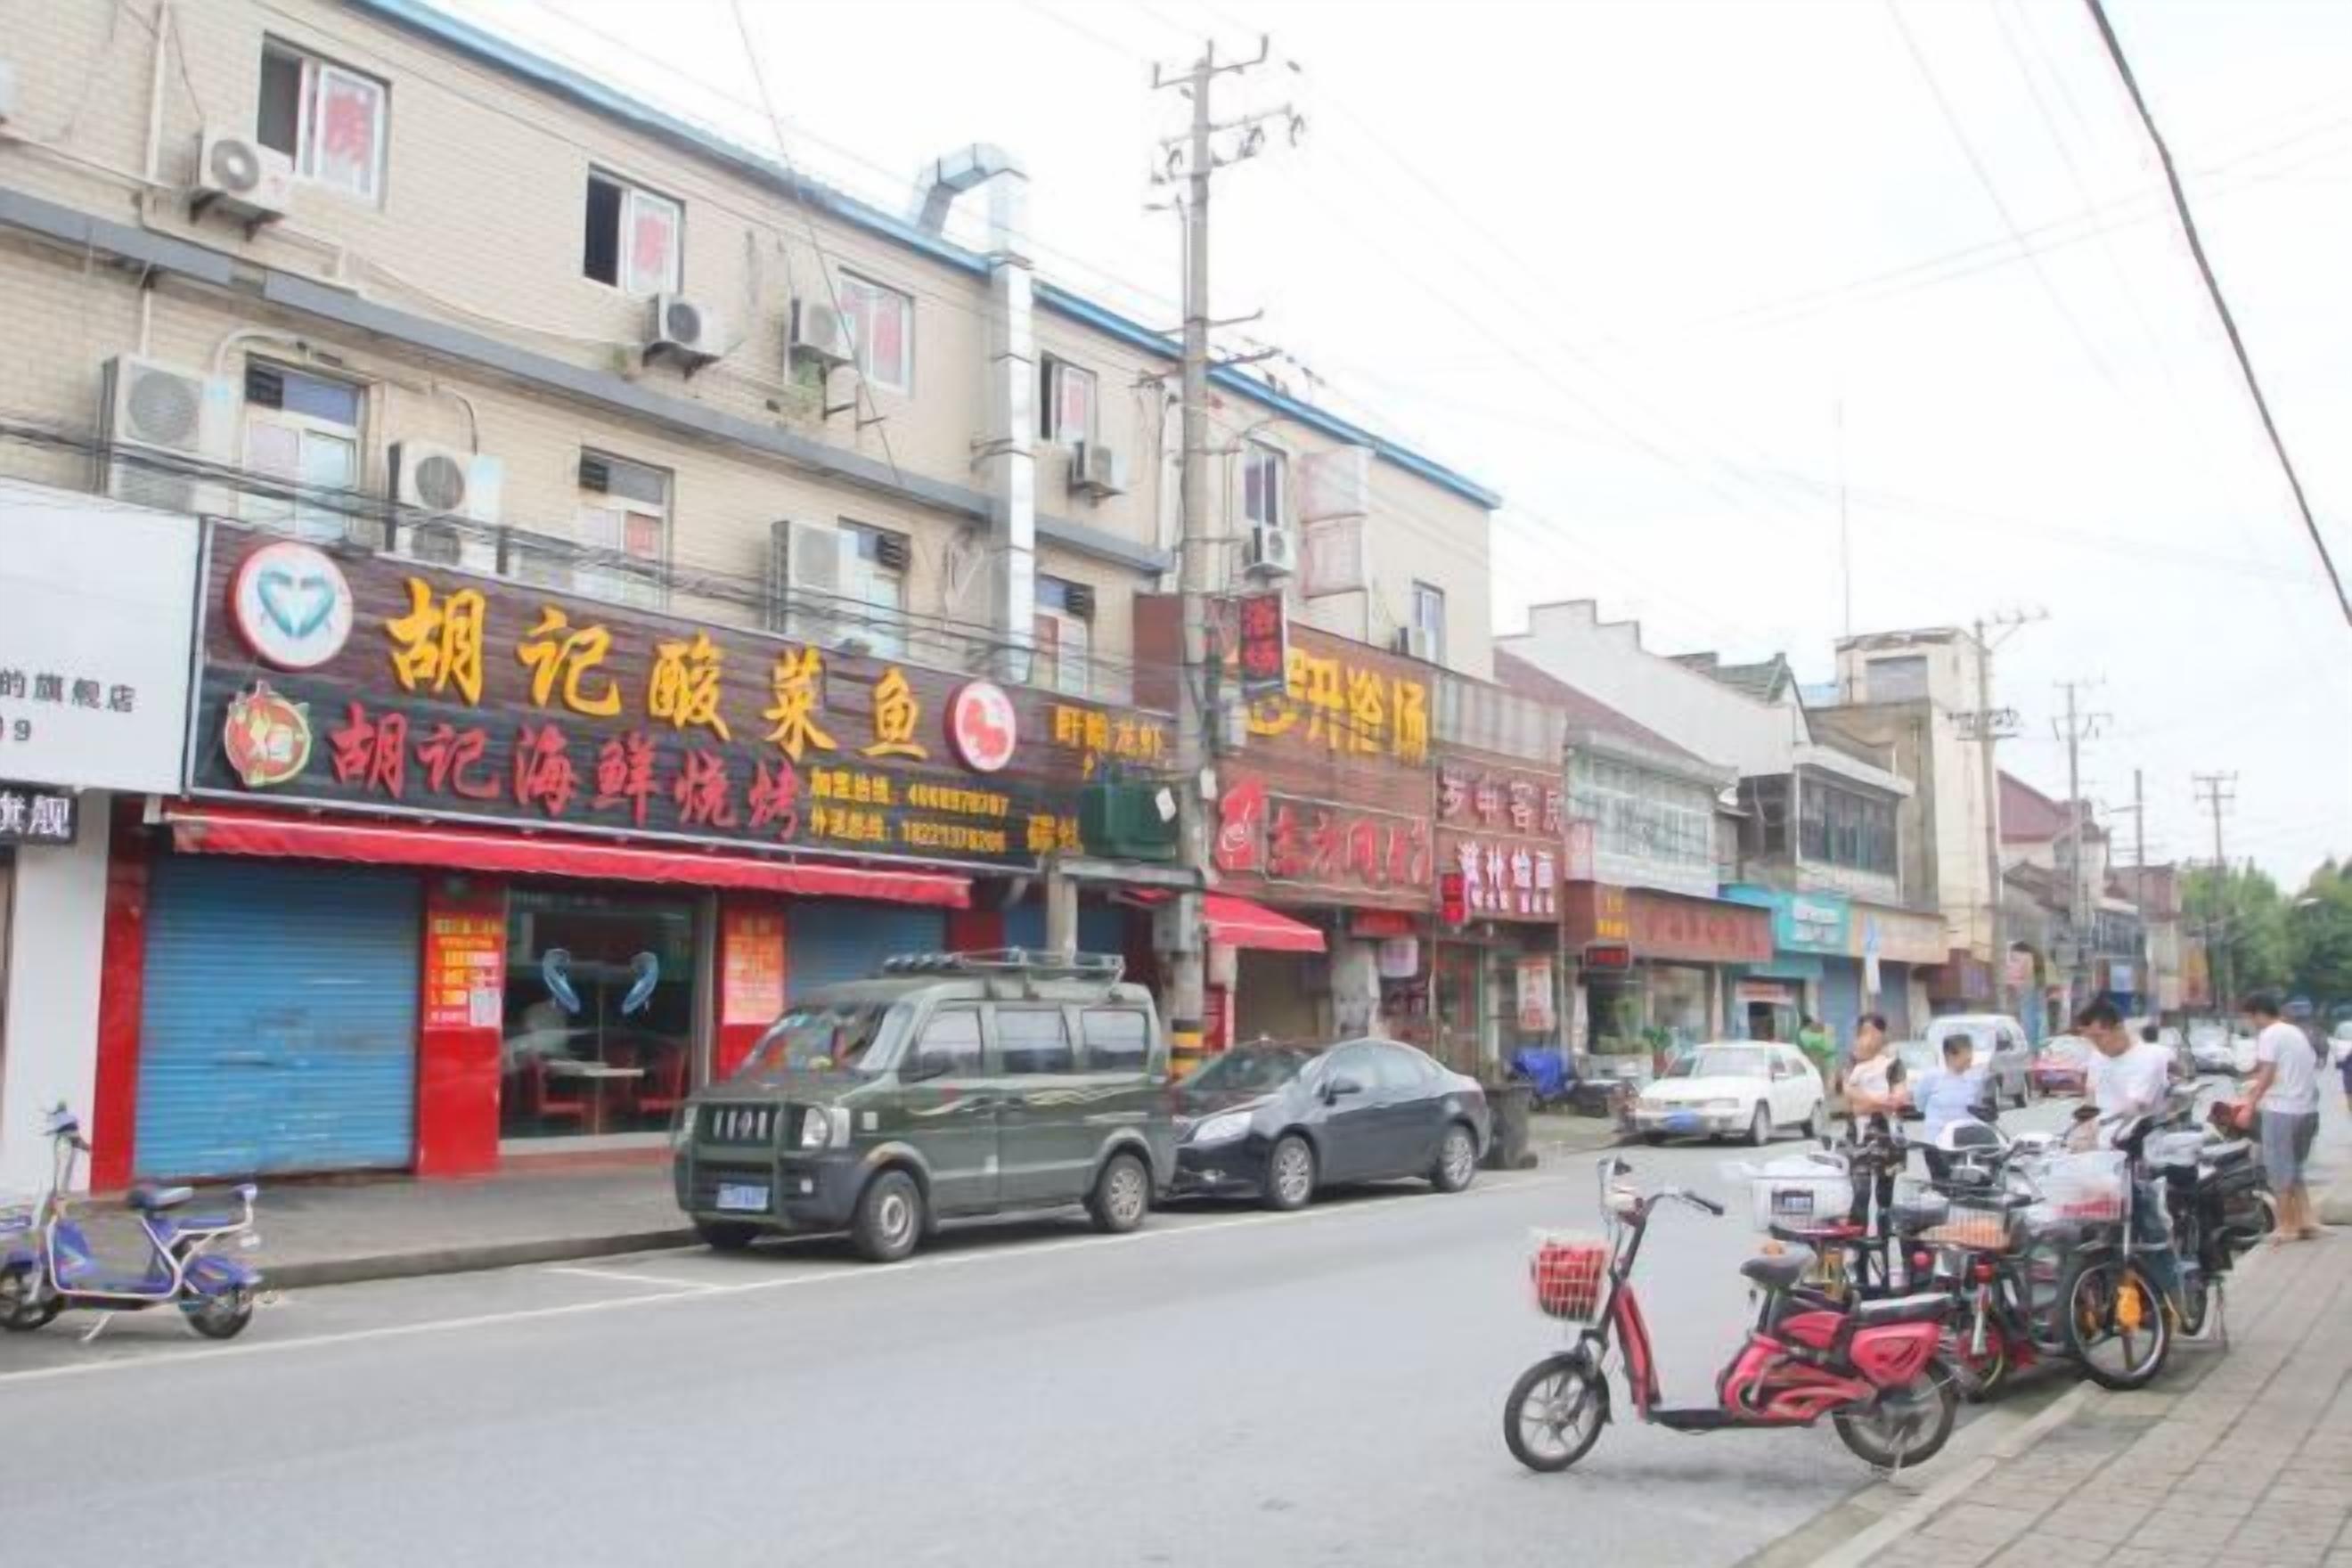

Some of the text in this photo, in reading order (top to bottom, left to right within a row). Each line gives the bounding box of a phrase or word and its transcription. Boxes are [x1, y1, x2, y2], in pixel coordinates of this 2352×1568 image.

[385, 575, 928, 761] 胡记酸菜鱼
[326, 702, 800, 842] 胡记海鲜烧烤
